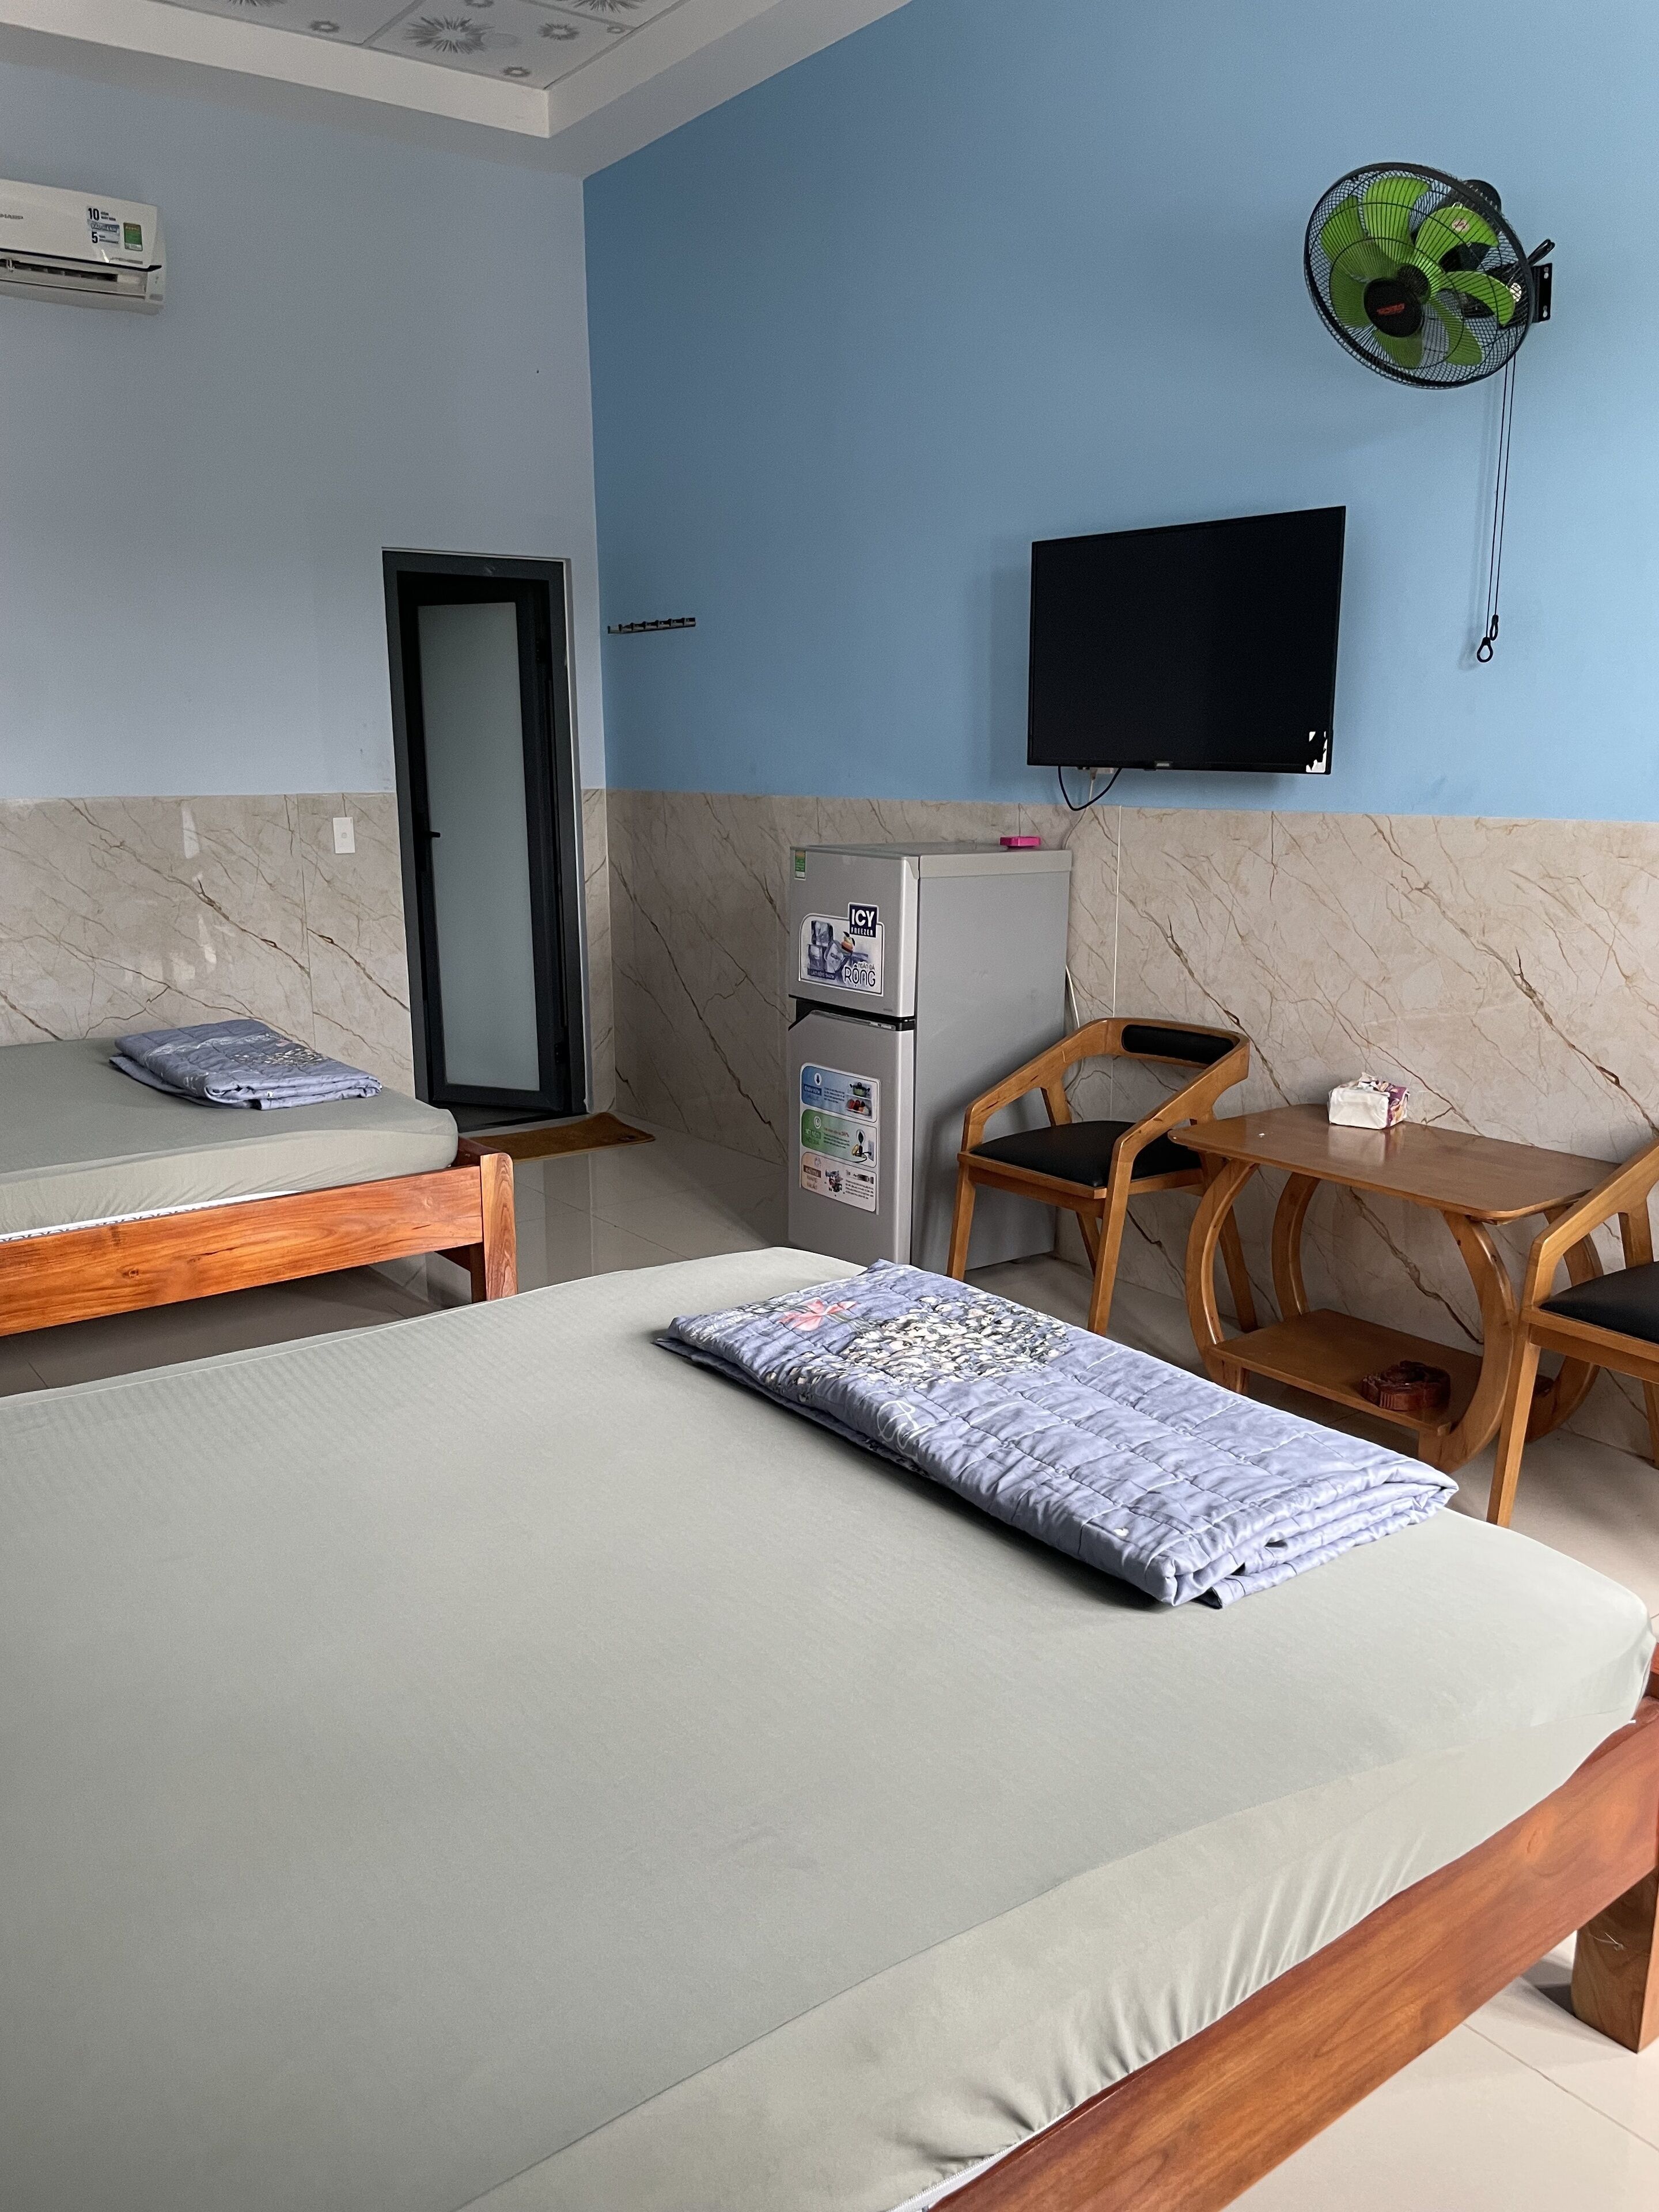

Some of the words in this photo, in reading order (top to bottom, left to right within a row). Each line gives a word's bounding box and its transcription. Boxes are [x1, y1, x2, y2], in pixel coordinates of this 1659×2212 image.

[88, 208, 99, 221] 10
[92, 231, 98, 243] 5
[851, 909, 874, 927] ICY
[851, 927, 873, 936] FREEZER
[844, 964, 876, 987] RỘNG
